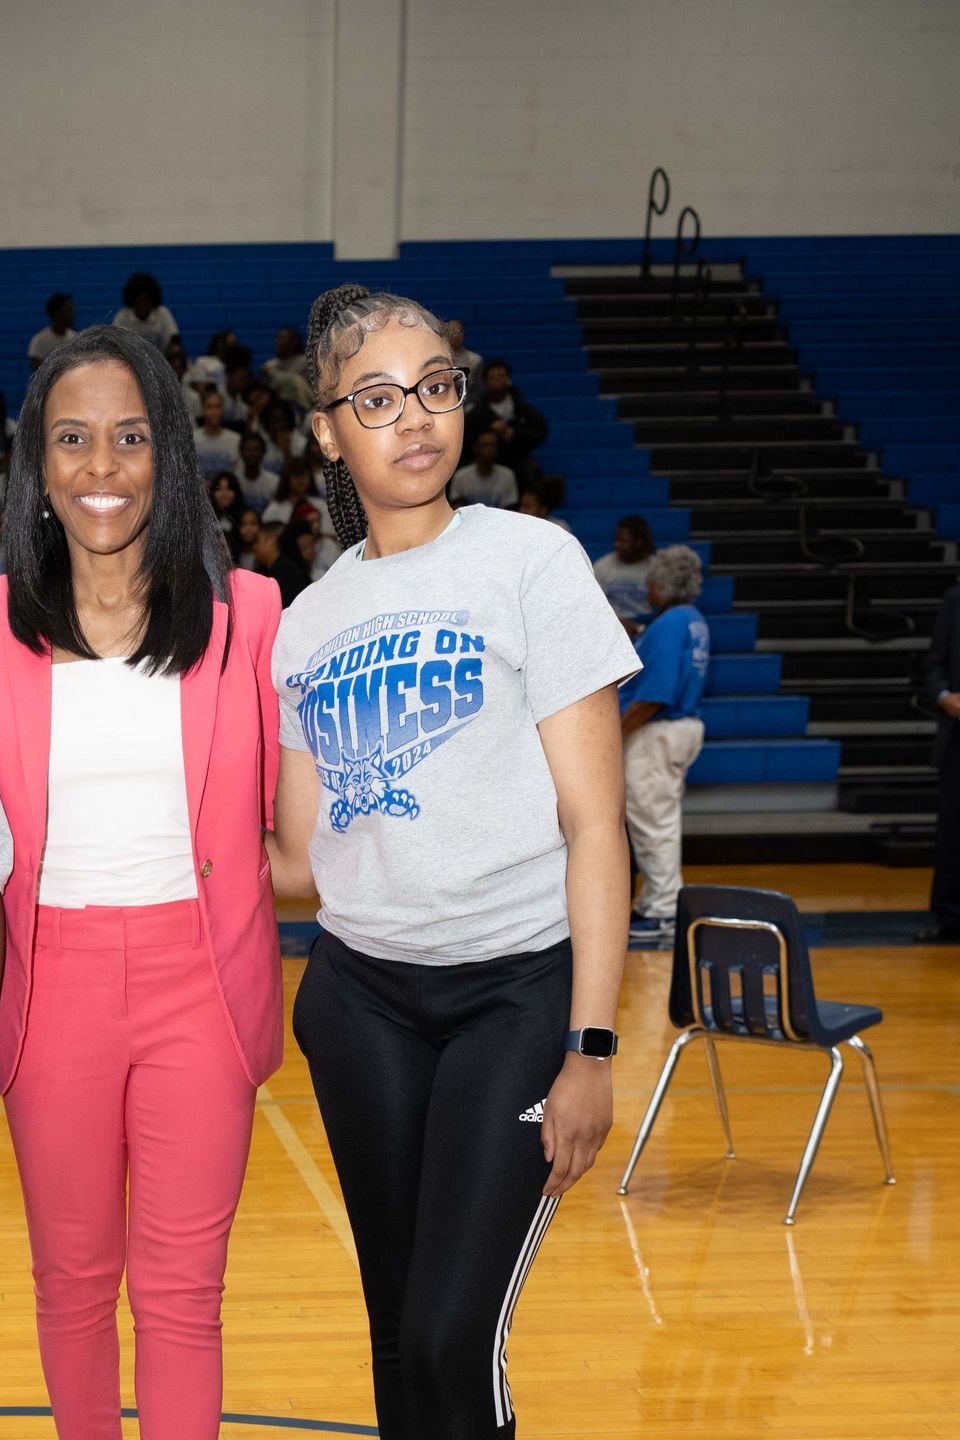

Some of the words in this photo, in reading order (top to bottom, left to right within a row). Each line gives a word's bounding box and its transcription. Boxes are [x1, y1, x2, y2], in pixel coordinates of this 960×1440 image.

[362, 614, 394, 638] HIGH
[396, 610, 459, 629] SCHOOL
[434, 629, 486, 655] ON
[391, 740, 432, 778] 2024
